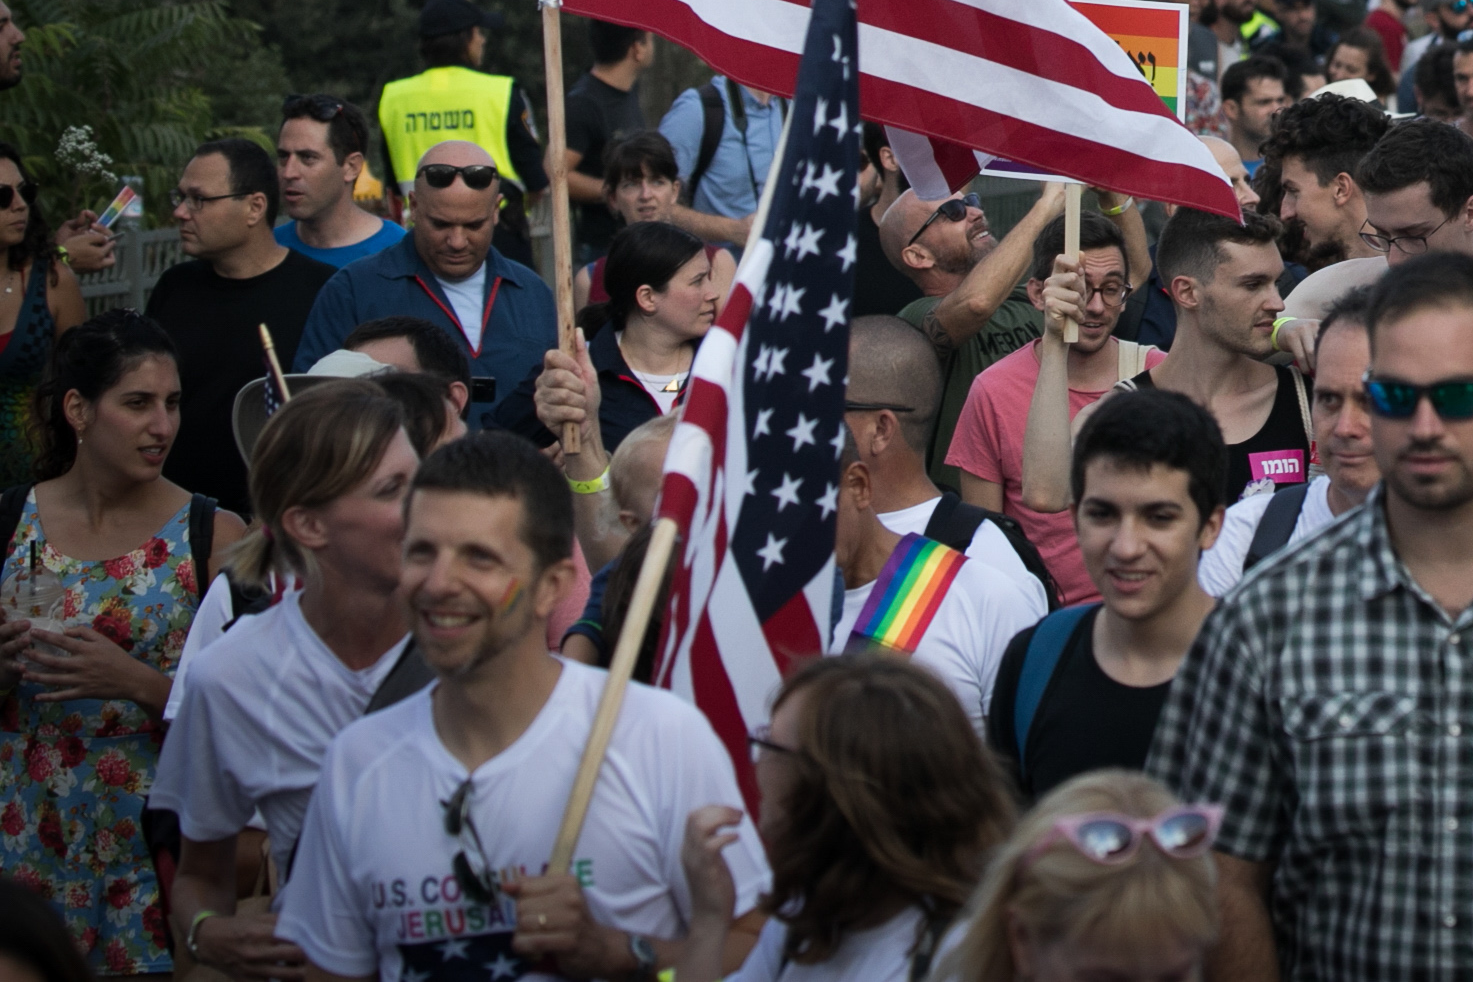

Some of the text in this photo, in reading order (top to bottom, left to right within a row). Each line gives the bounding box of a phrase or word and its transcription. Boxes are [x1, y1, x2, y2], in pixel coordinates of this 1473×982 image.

[405, 109, 474, 133] משטרה
[1261, 458, 1300, 475] הומו
[371, 878, 414, 909] U.S.
[397, 901, 517, 940] JERUSAL
